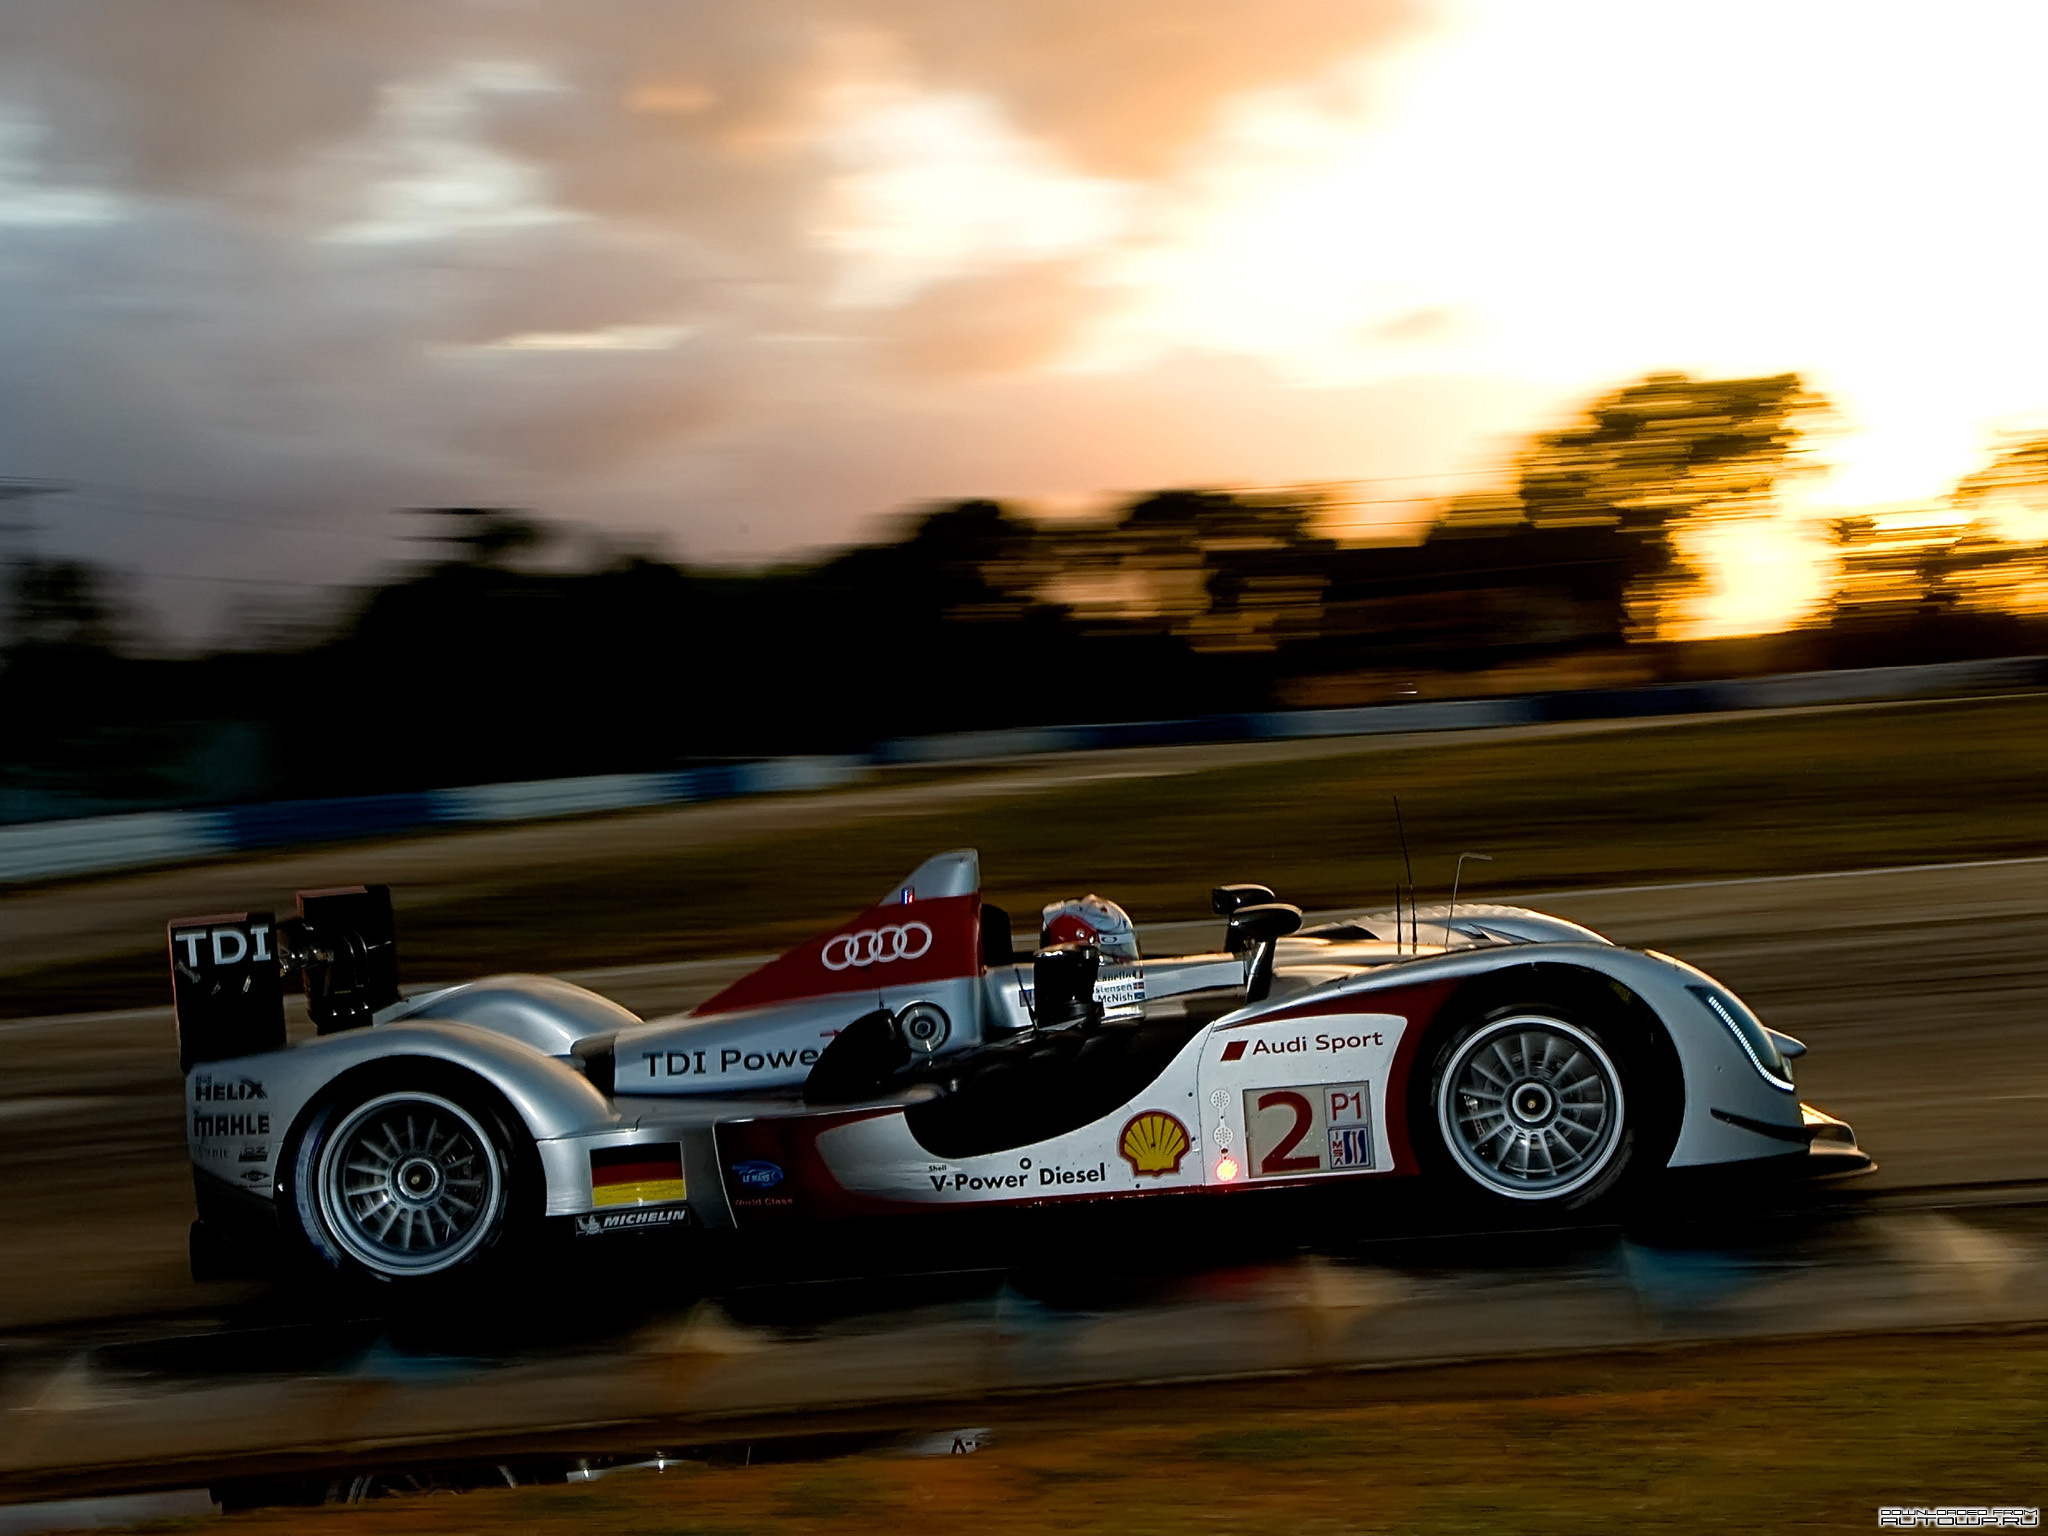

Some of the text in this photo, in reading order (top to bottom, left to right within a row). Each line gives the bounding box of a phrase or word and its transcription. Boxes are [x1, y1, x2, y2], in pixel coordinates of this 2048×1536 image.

[175, 923, 272, 968] TDI
[1097, 991, 1134, 1003] McNish
[1252, 1031, 1384, 1056] Audi Sport
[642, 1047, 826, 1078] TDI Powe
[194, 1078, 269, 1102] HELIX
[1330, 1091, 1362, 1122] P1
[193, 1113, 271, 1138] MAHLE
[1257, 1090, 1321, 1174] 2
[1332, 1131, 1344, 1166] IMSA
[928, 1164, 947, 1173] Shell
[930, 1162, 1107, 1193] V-Power Diesel
[603, 1208, 686, 1228] MICHELIN
